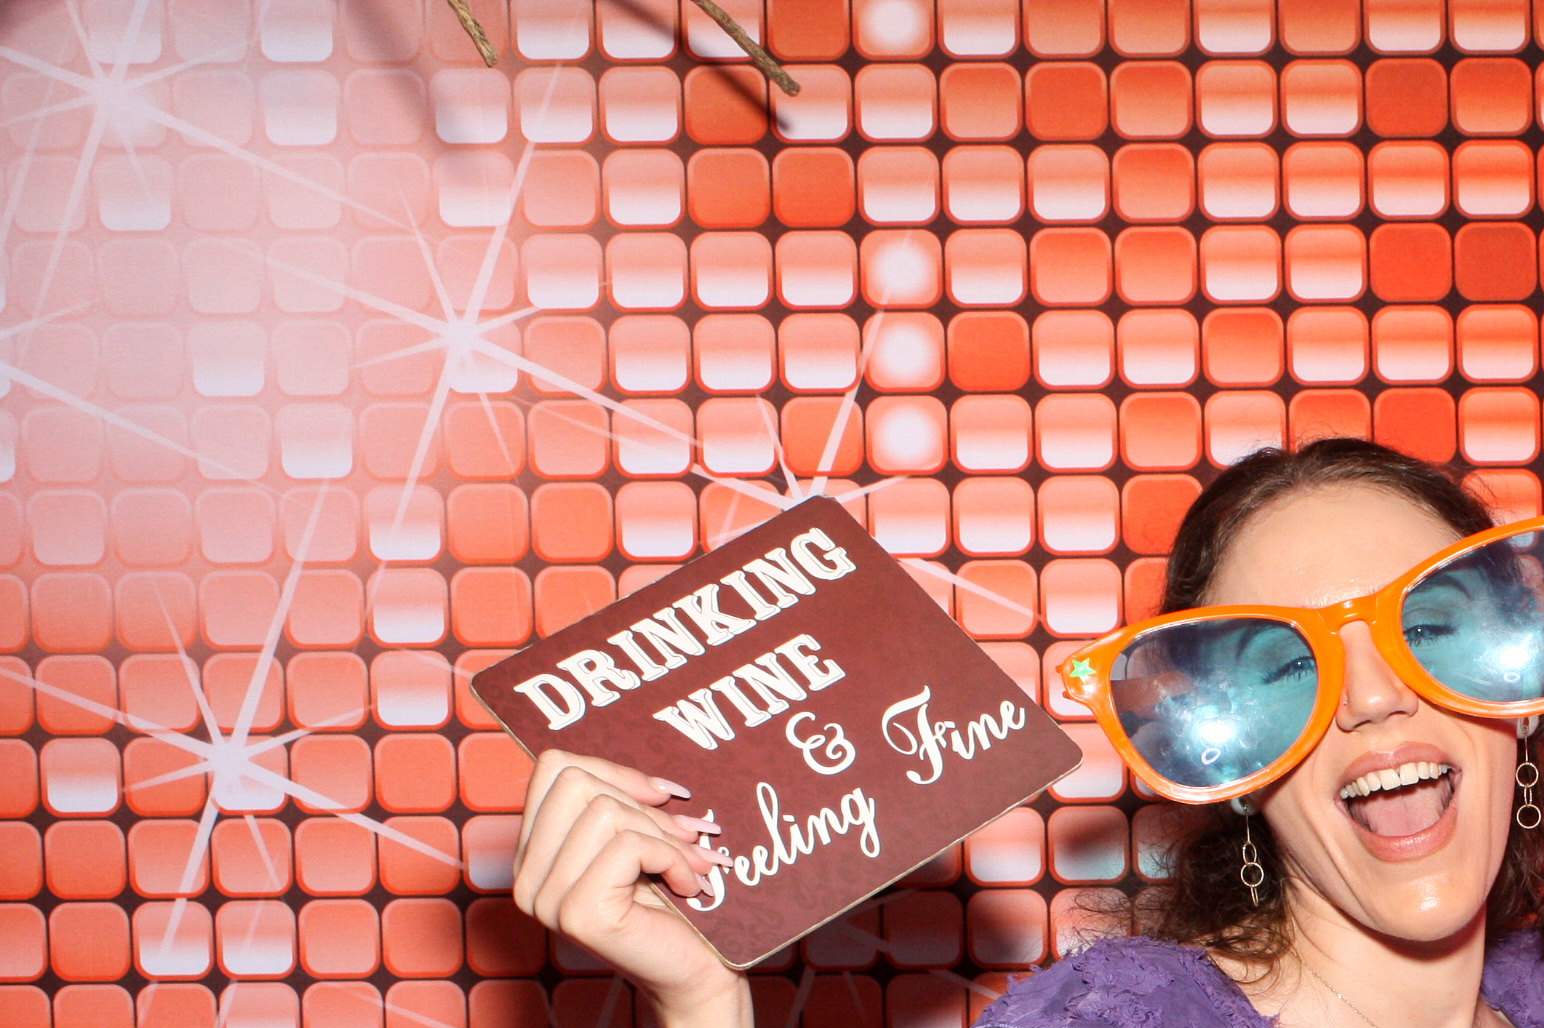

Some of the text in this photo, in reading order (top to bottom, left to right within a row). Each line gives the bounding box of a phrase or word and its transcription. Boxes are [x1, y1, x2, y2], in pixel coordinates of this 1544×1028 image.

[513, 527, 857, 731] DRINKING
[652, 634, 847, 751] WINE
[785, 711, 856, 776] &
[881, 685, 1026, 785] Fine
